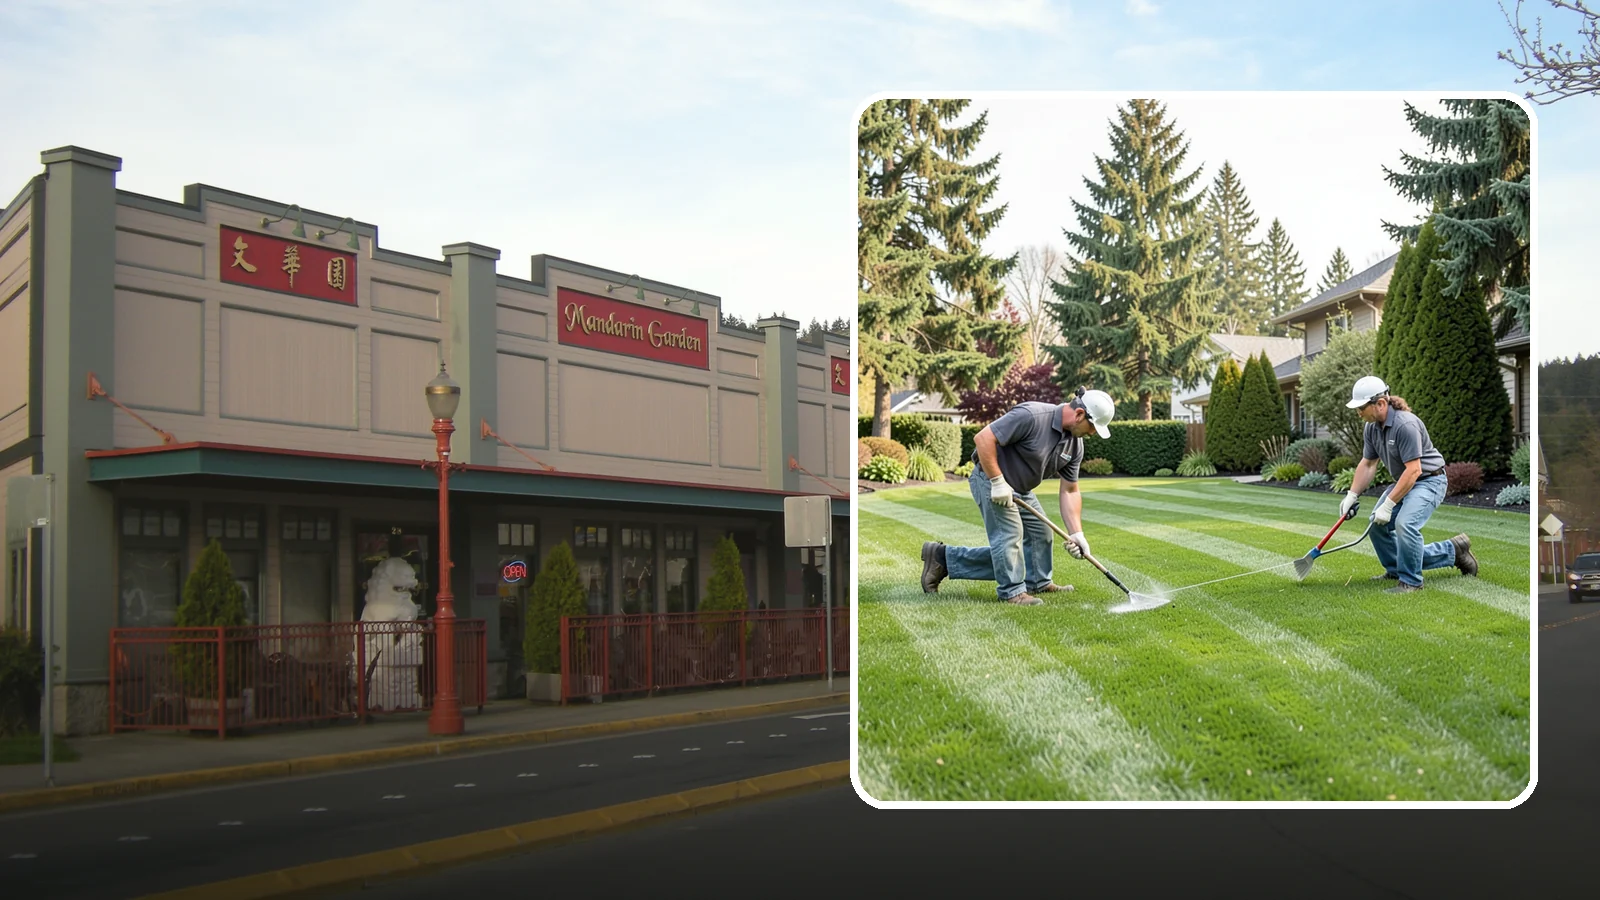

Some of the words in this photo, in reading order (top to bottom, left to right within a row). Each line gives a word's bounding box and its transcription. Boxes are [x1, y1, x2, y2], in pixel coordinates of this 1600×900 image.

[231, 235, 347, 291] 文華園
[564, 302, 644, 341] Mandarin
[648, 320, 701, 352] Garden
[503, 565, 526, 578] OPEN
